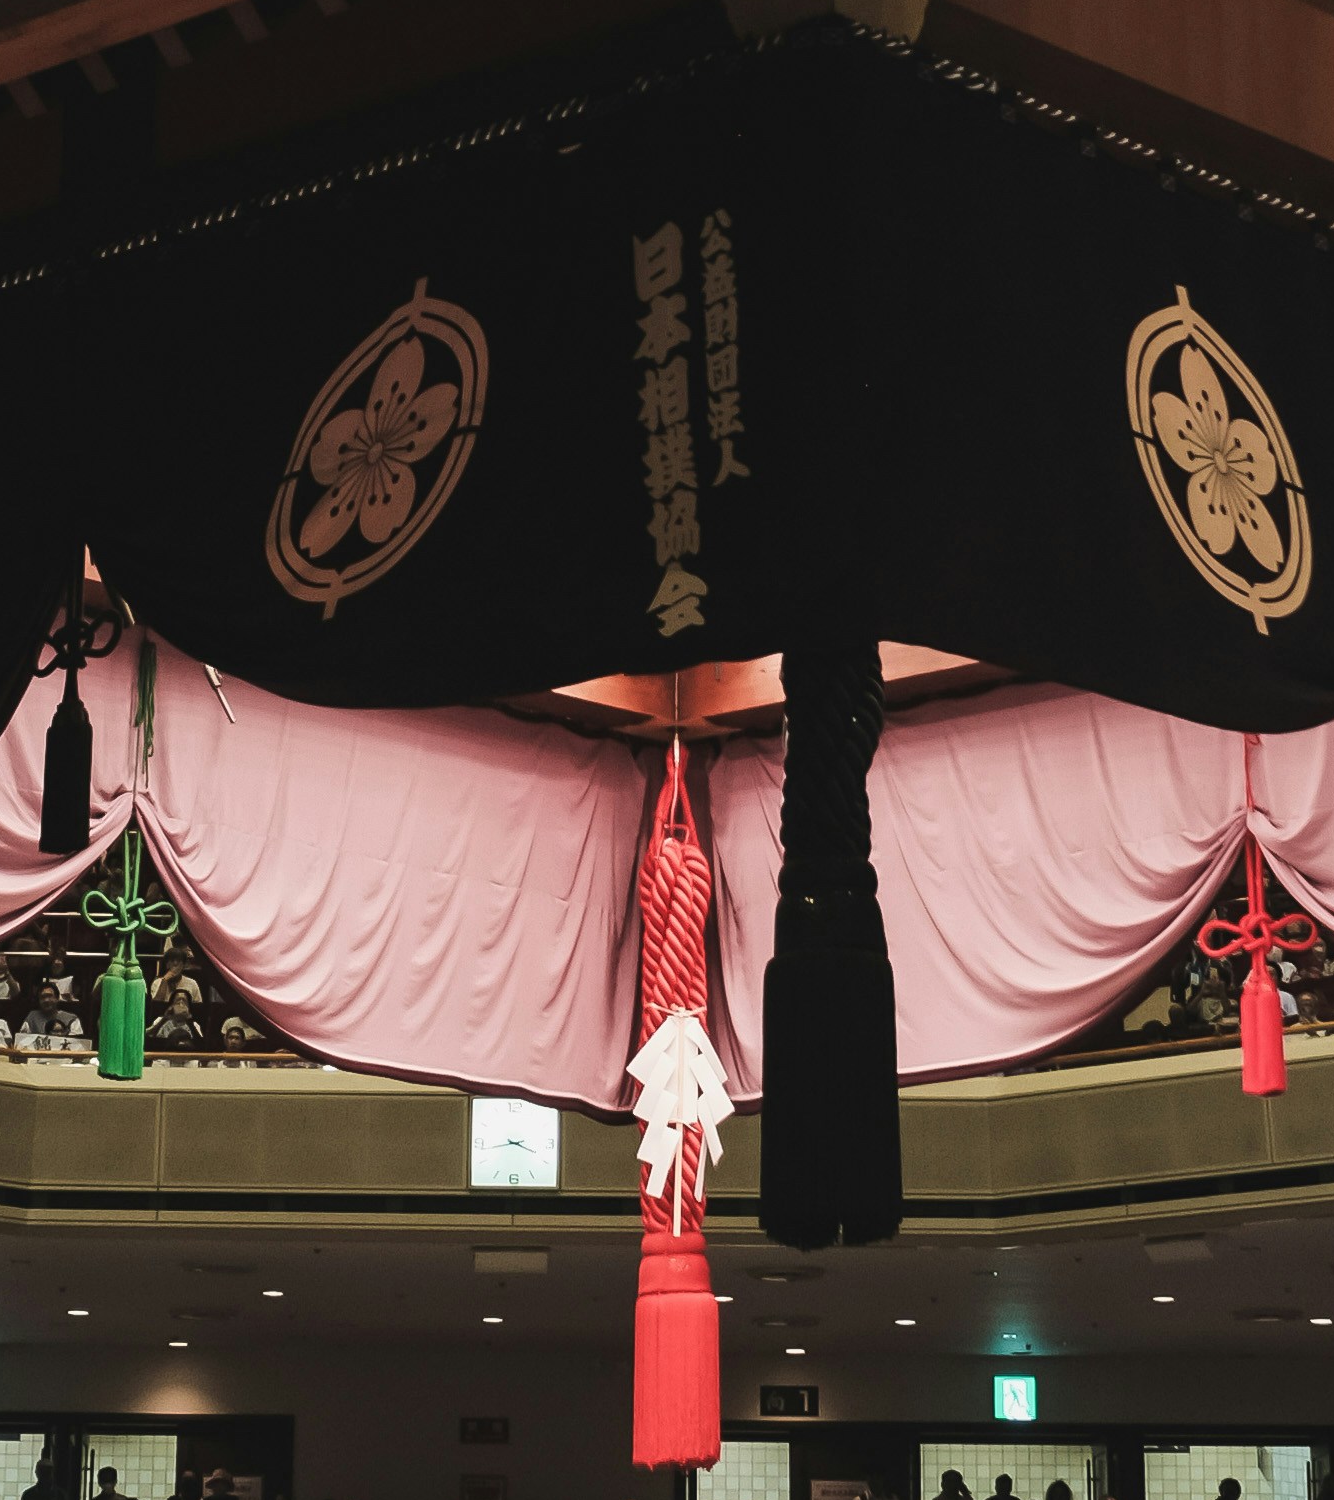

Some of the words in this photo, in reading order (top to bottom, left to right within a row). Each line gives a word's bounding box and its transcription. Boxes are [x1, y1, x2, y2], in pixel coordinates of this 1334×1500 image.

[700, 208, 751, 488] 公益財団法人
[631, 221, 708, 638] 日本相撲協会
[507, 1102, 523, 1113] 12
[474, 1138, 485, 1150] 9
[509, 1173, 519, 1184] 6
[799, 1390, 809, 1412] 1
